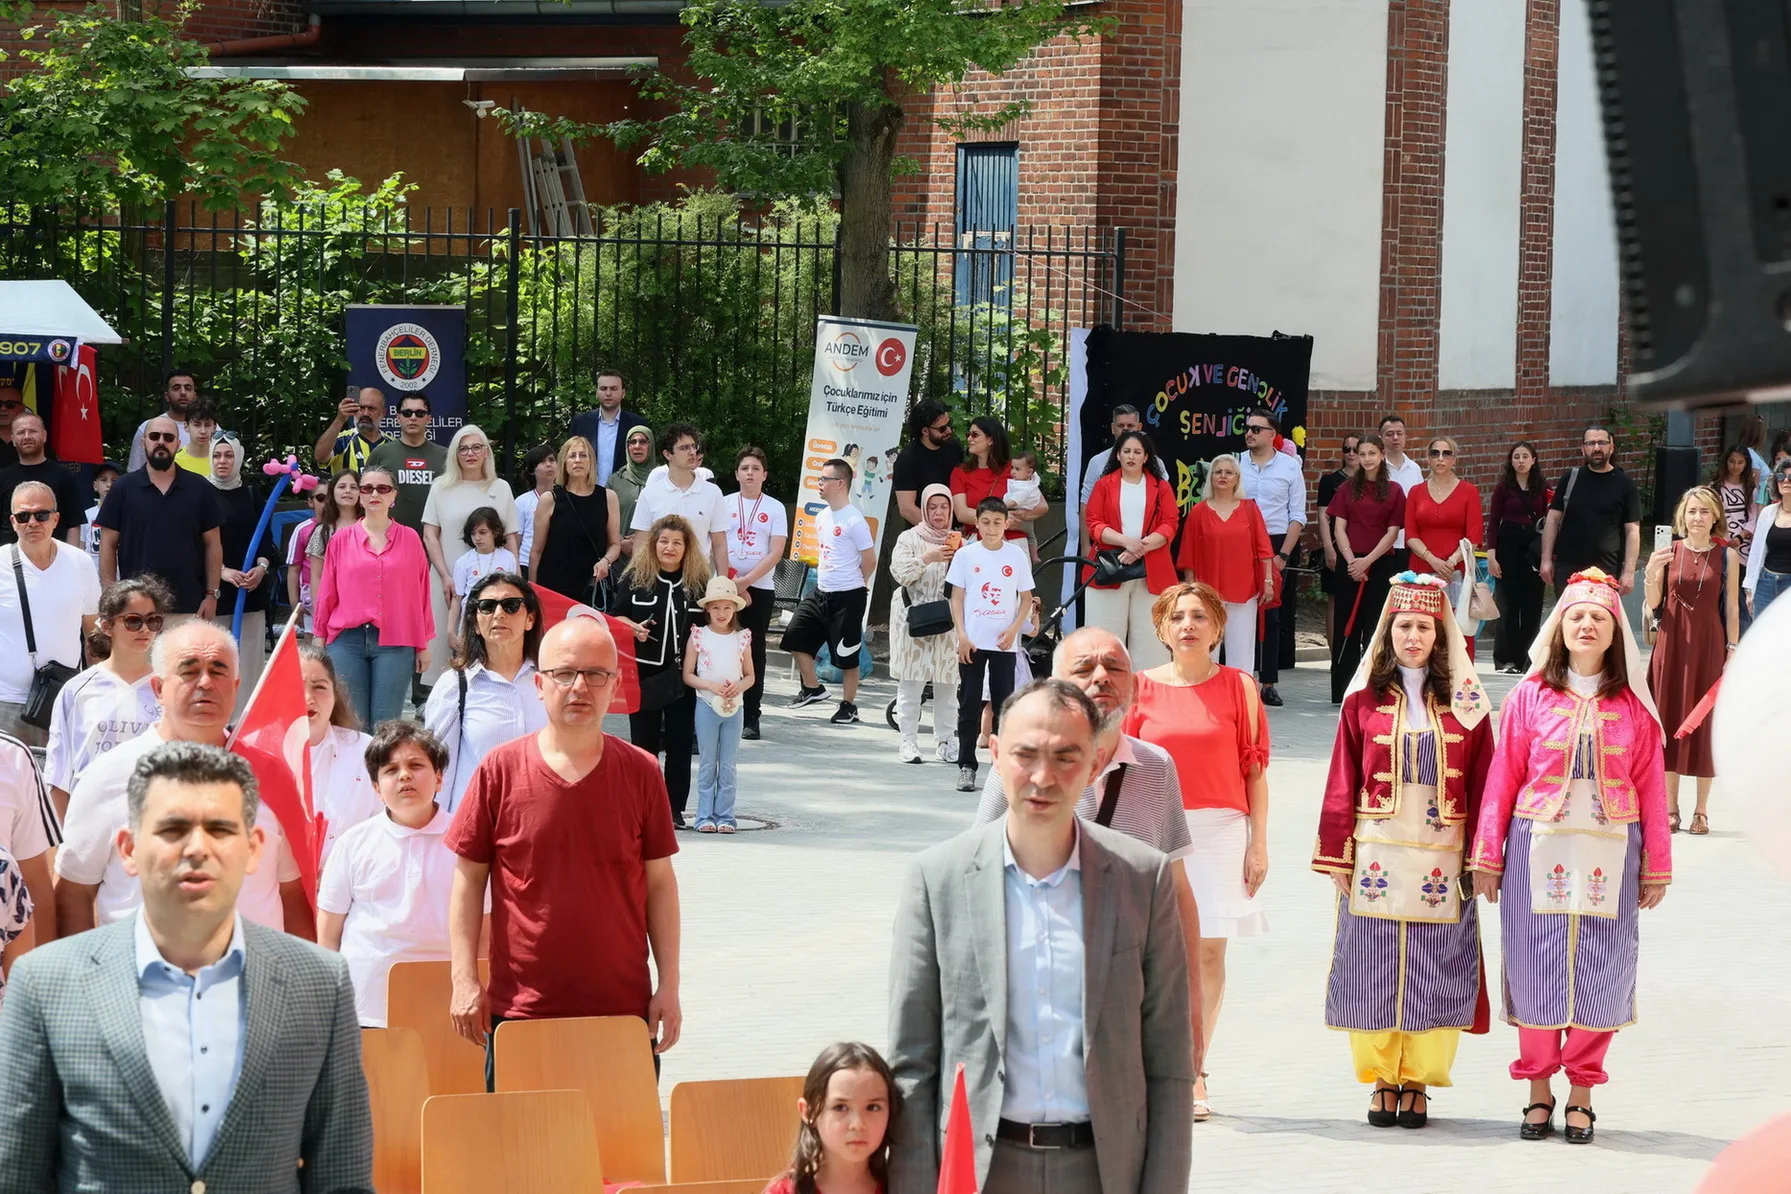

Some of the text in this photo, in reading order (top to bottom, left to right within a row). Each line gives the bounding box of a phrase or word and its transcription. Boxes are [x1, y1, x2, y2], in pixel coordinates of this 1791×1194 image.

[824, 342, 869, 357] ANDEM
[1202, 364, 1224, 384] VE
[400, 381, 418, 389] 2002
[823, 385, 898, 404] Çocuklarımız için
[826, 401, 888, 418] Türkçe Eğitimi
[398, 469, 434, 485] DIESEL
